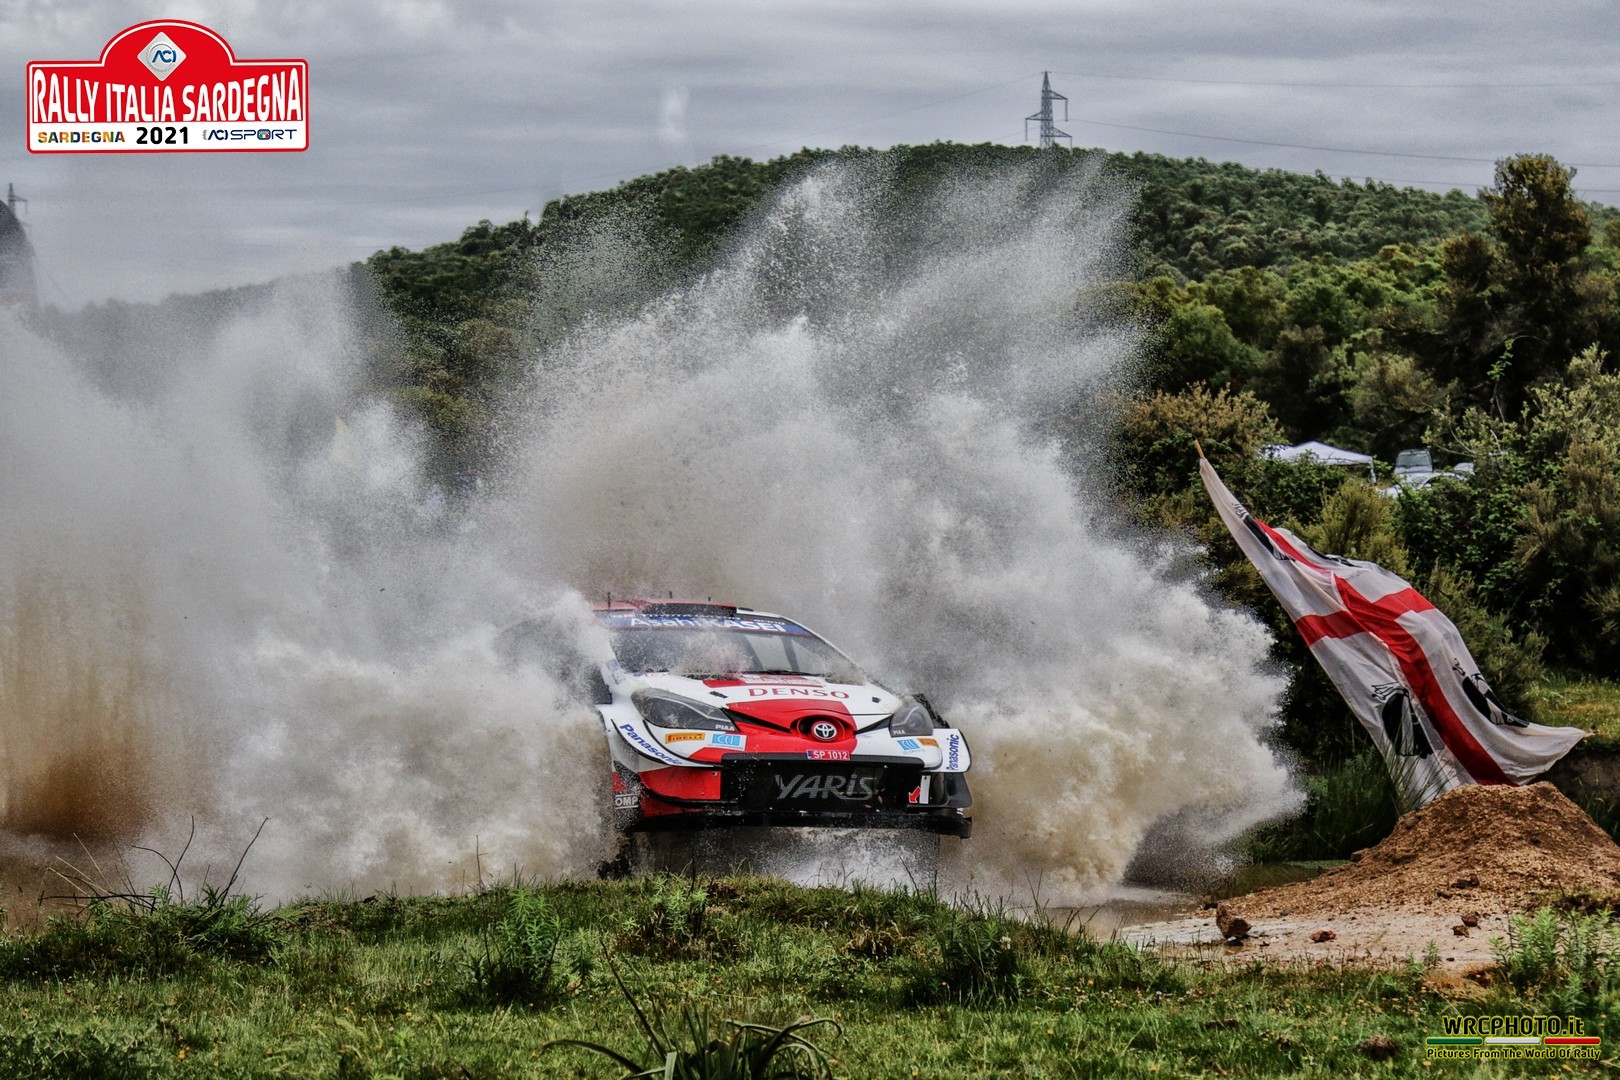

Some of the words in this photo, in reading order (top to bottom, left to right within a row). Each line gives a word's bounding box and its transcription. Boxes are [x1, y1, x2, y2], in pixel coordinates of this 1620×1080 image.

[748, 688, 850, 699] DENSO
[619, 723, 683, 765] Panasonic
[813, 750, 826, 760] SP
[828, 750, 848, 760] 1012
[946, 734, 959, 771] Panasonic
[615, 796, 638, 806] OMP
